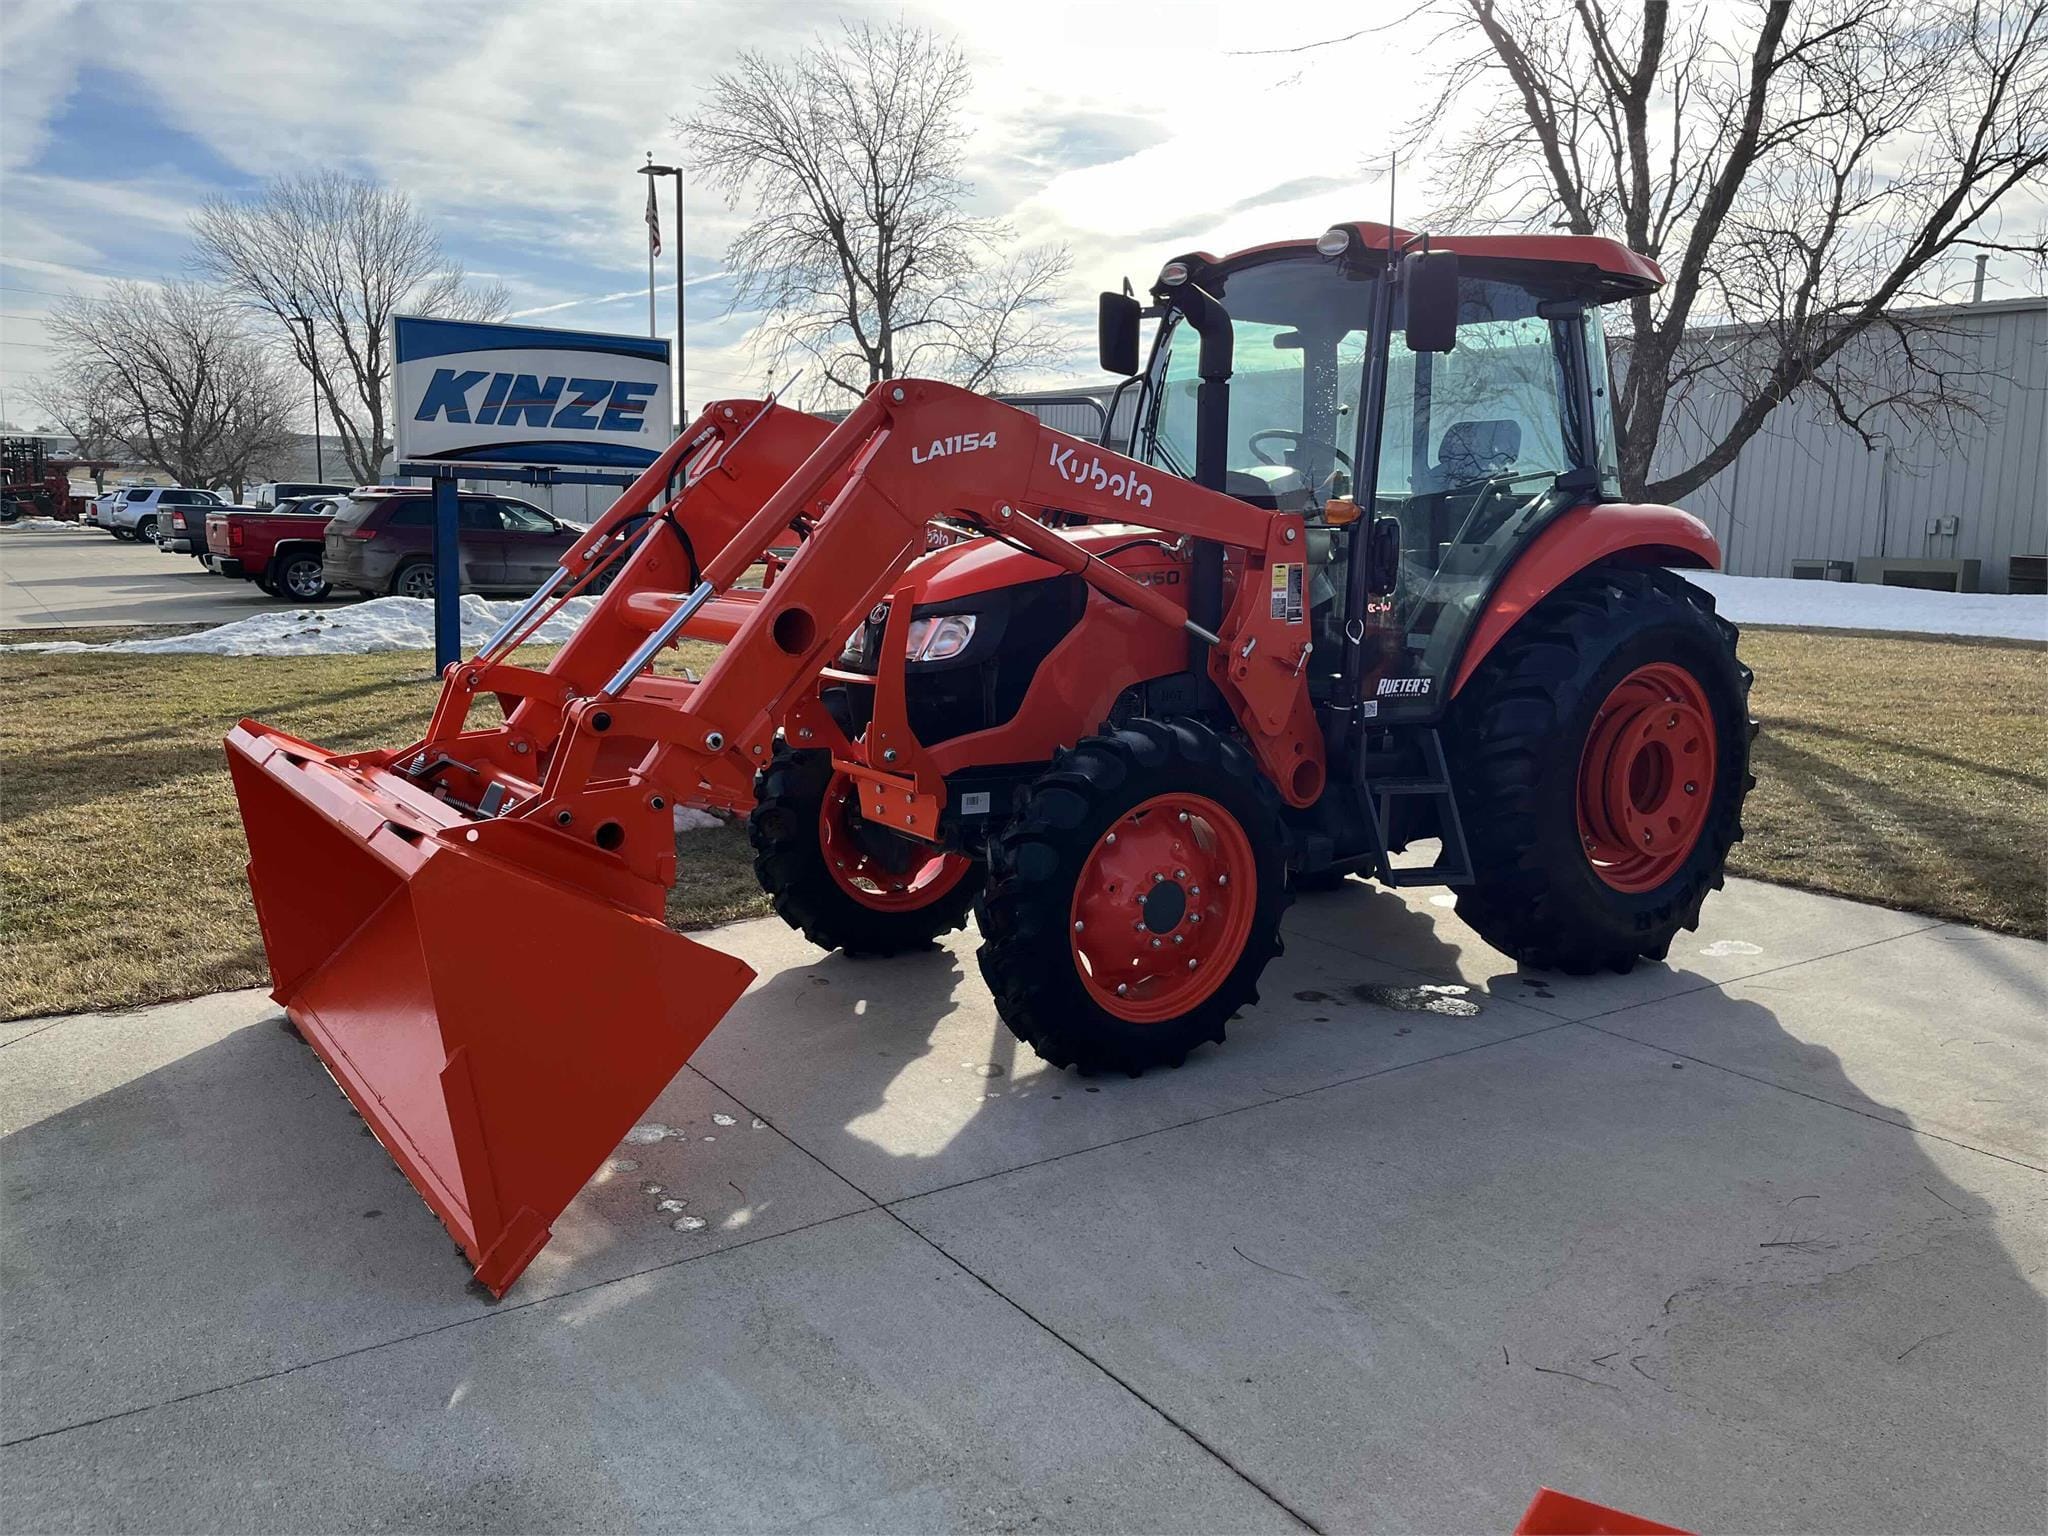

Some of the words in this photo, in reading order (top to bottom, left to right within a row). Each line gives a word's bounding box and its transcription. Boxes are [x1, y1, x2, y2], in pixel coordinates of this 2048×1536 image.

[414, 368, 658, 432] KINZE
[912, 431, 997, 464] LA1154
[1049, 443, 1153, 507] Kubota
[927, 527, 949, 546] bota
[1376, 678, 1432, 696] RUETER'S
